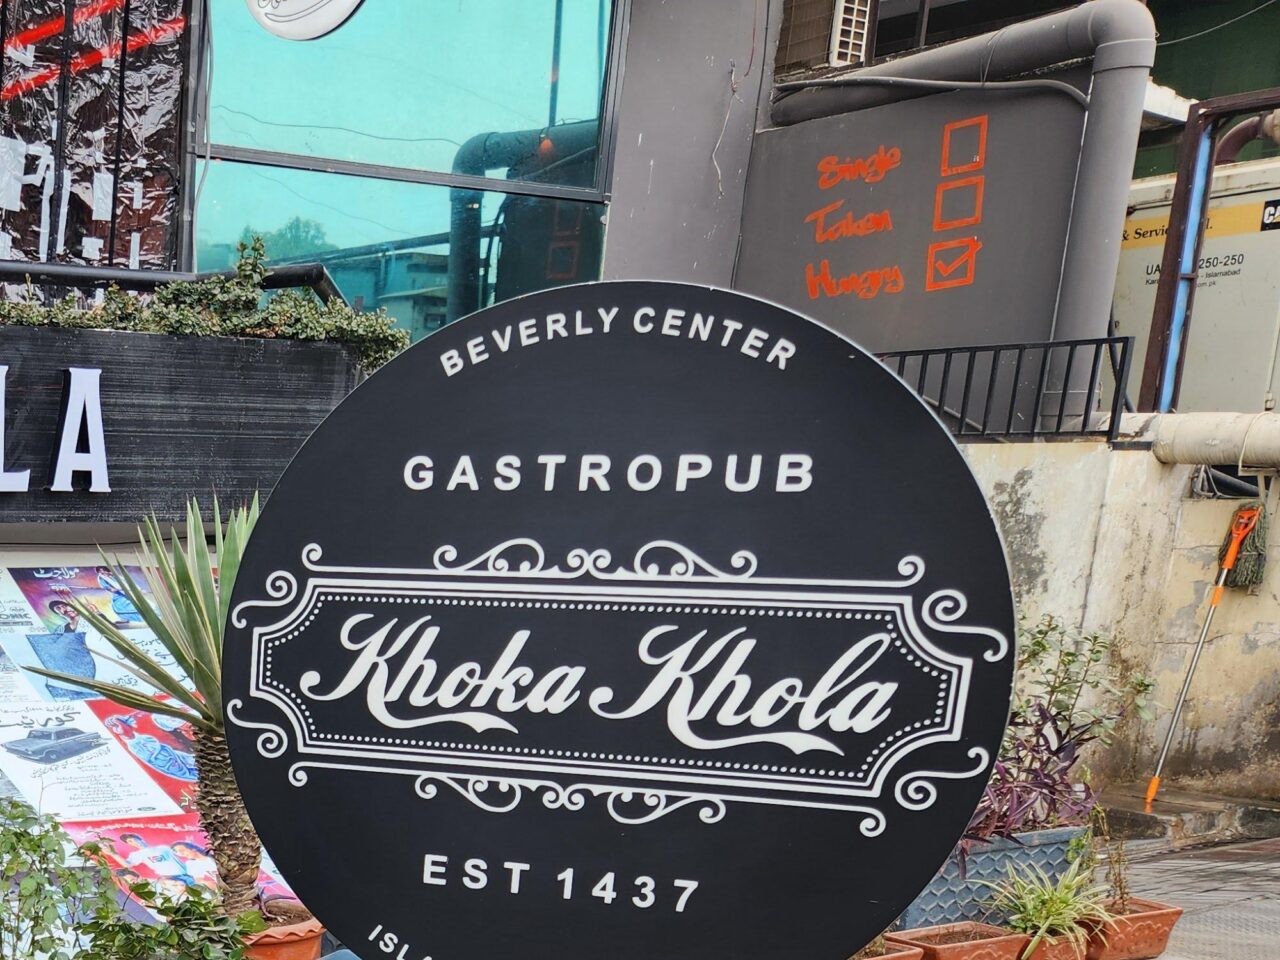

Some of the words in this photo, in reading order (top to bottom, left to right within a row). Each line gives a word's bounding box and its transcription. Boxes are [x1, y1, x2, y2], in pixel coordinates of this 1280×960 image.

[816, 144, 902, 190] Single
[804, 198, 894, 244] Taken
[1263, 205, 1280, 224] CA
[805, 258, 905, 300] Hungry
[1145, 263, 1162, 276] UA
[440, 306, 619, 377] BEVERLY
[633, 305, 796, 370] CENTER
[402, 453, 814, 493] GASTROPUB
[299, 612, 587, 735] Khoka
[588, 623, 900, 757] Khola
[422, 854, 531, 894] EST
[557, 867, 700, 912] 1437
